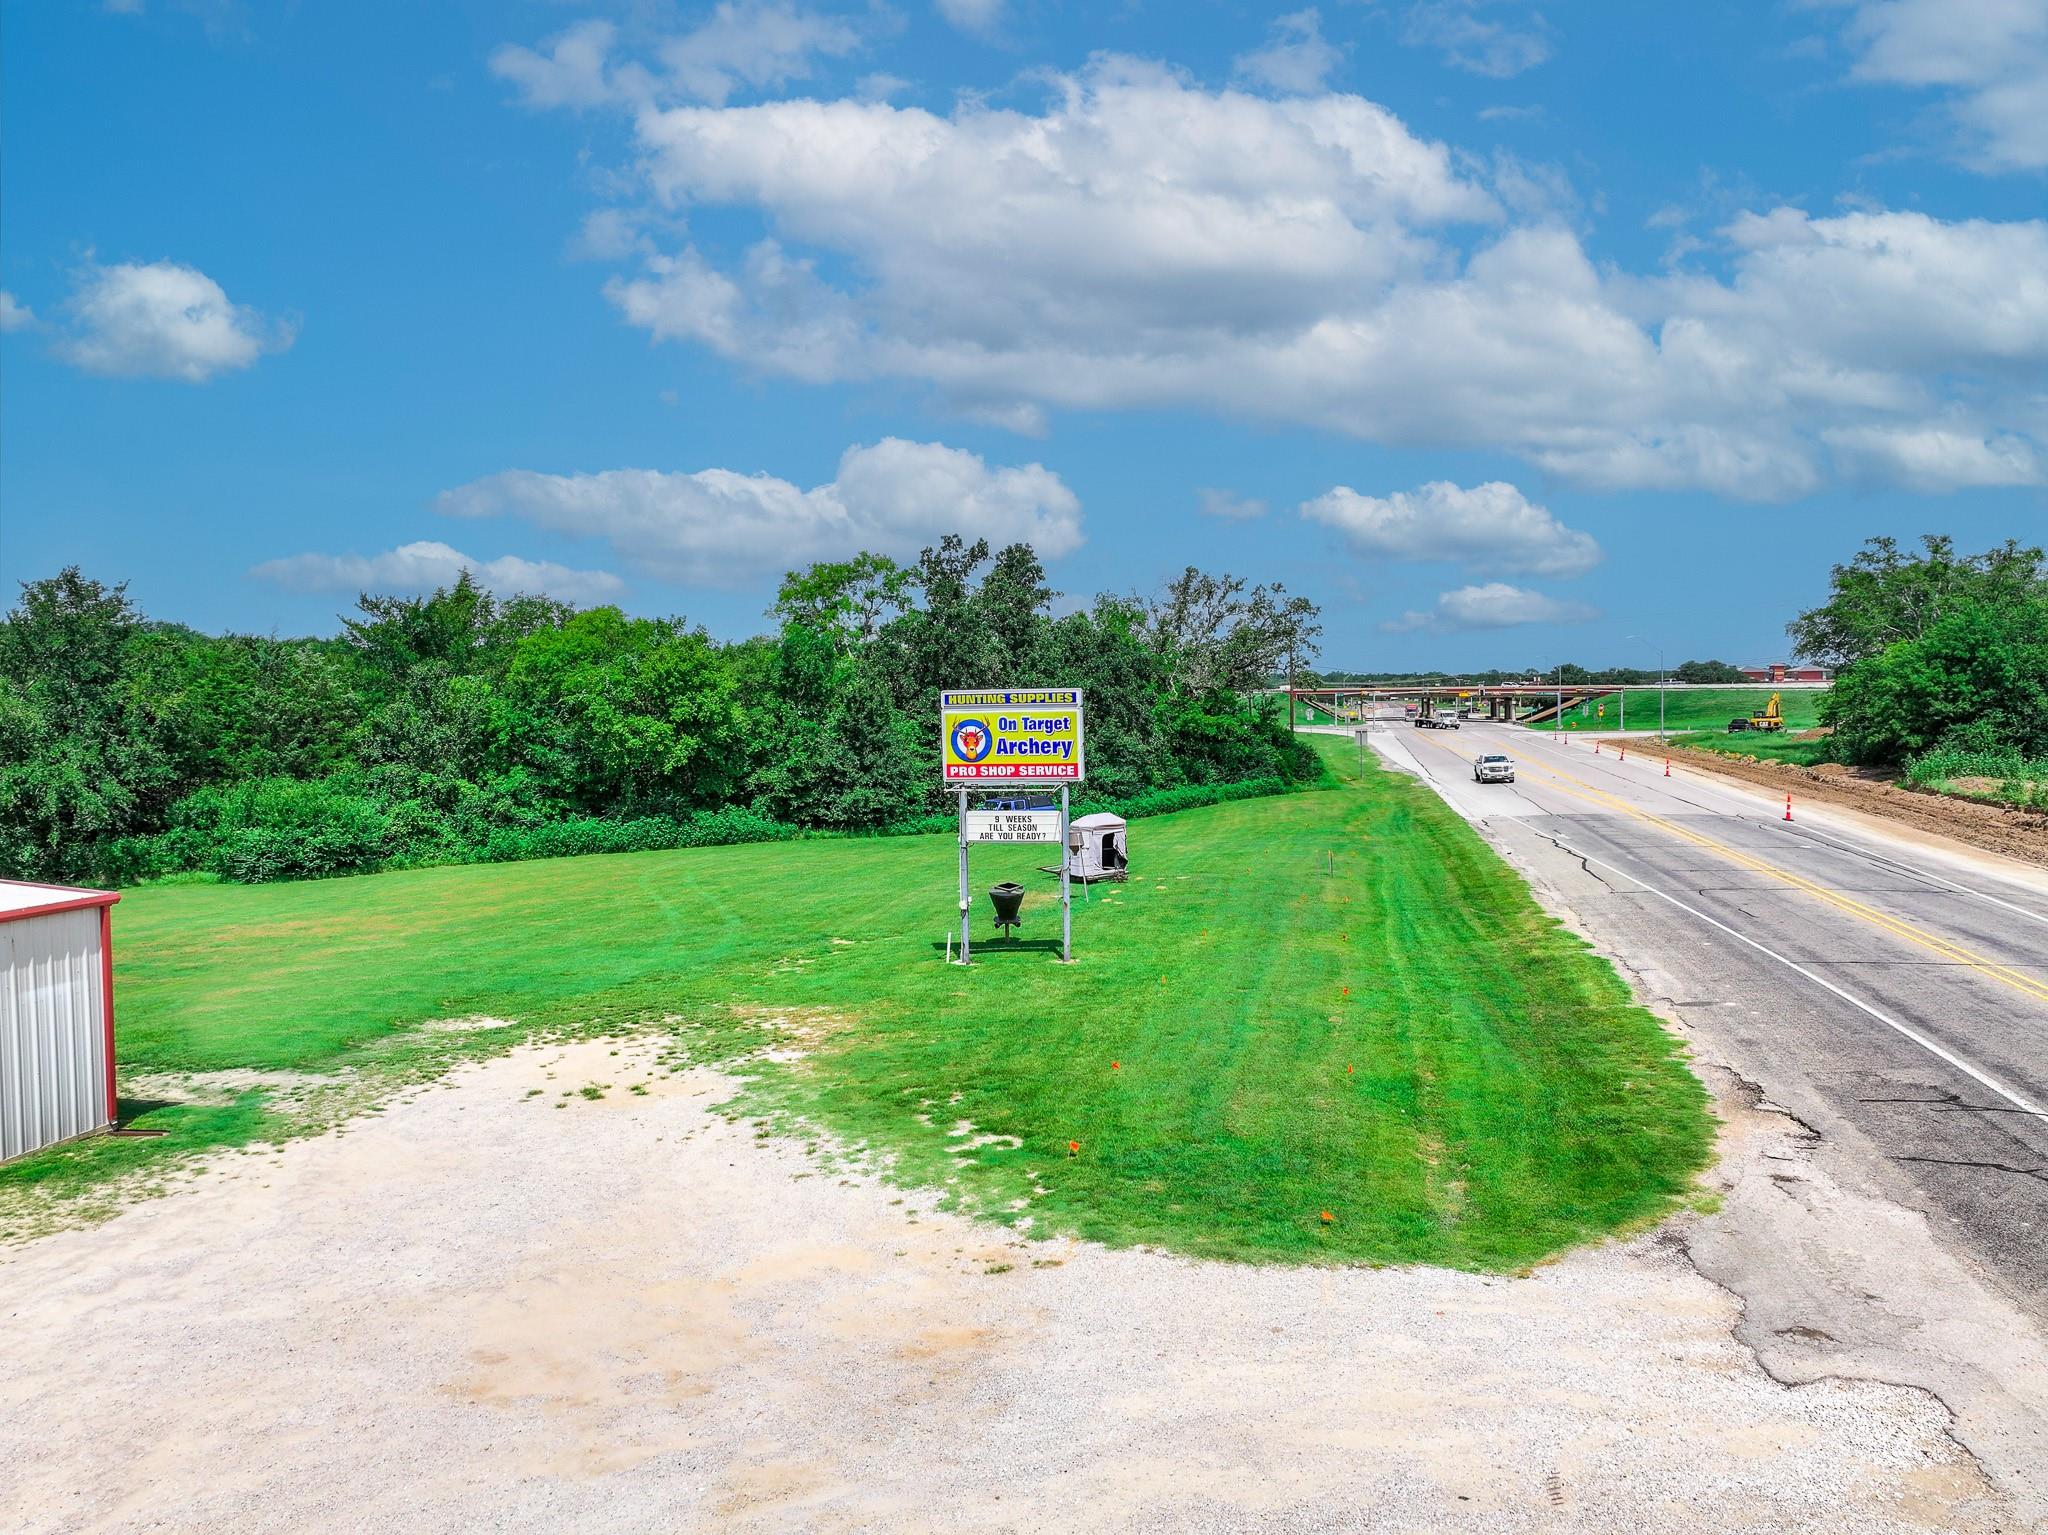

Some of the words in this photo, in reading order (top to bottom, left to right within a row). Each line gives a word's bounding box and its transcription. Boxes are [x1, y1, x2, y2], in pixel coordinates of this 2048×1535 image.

[948, 693, 1006, 705] HUNTING
[1009, 692, 1073, 704] SUPPLIES
[998, 717, 1017, 731] On
[1021, 716, 1070, 734] Target
[996, 738, 1073, 759] Archery
[950, 765, 977, 776] PRO
[979, 765, 1016, 776] SHOP
[1018, 765, 1075, 776] SERVICE
[994, 815, 1000, 823] 9
[1005, 815, 1032, 823] WEEKS
[988, 823, 1004, 832] TILL
[1008, 823, 1038, 832] SEASON
[979, 832, 994, 840] ARE
[997, 832, 1013, 840] YOU
